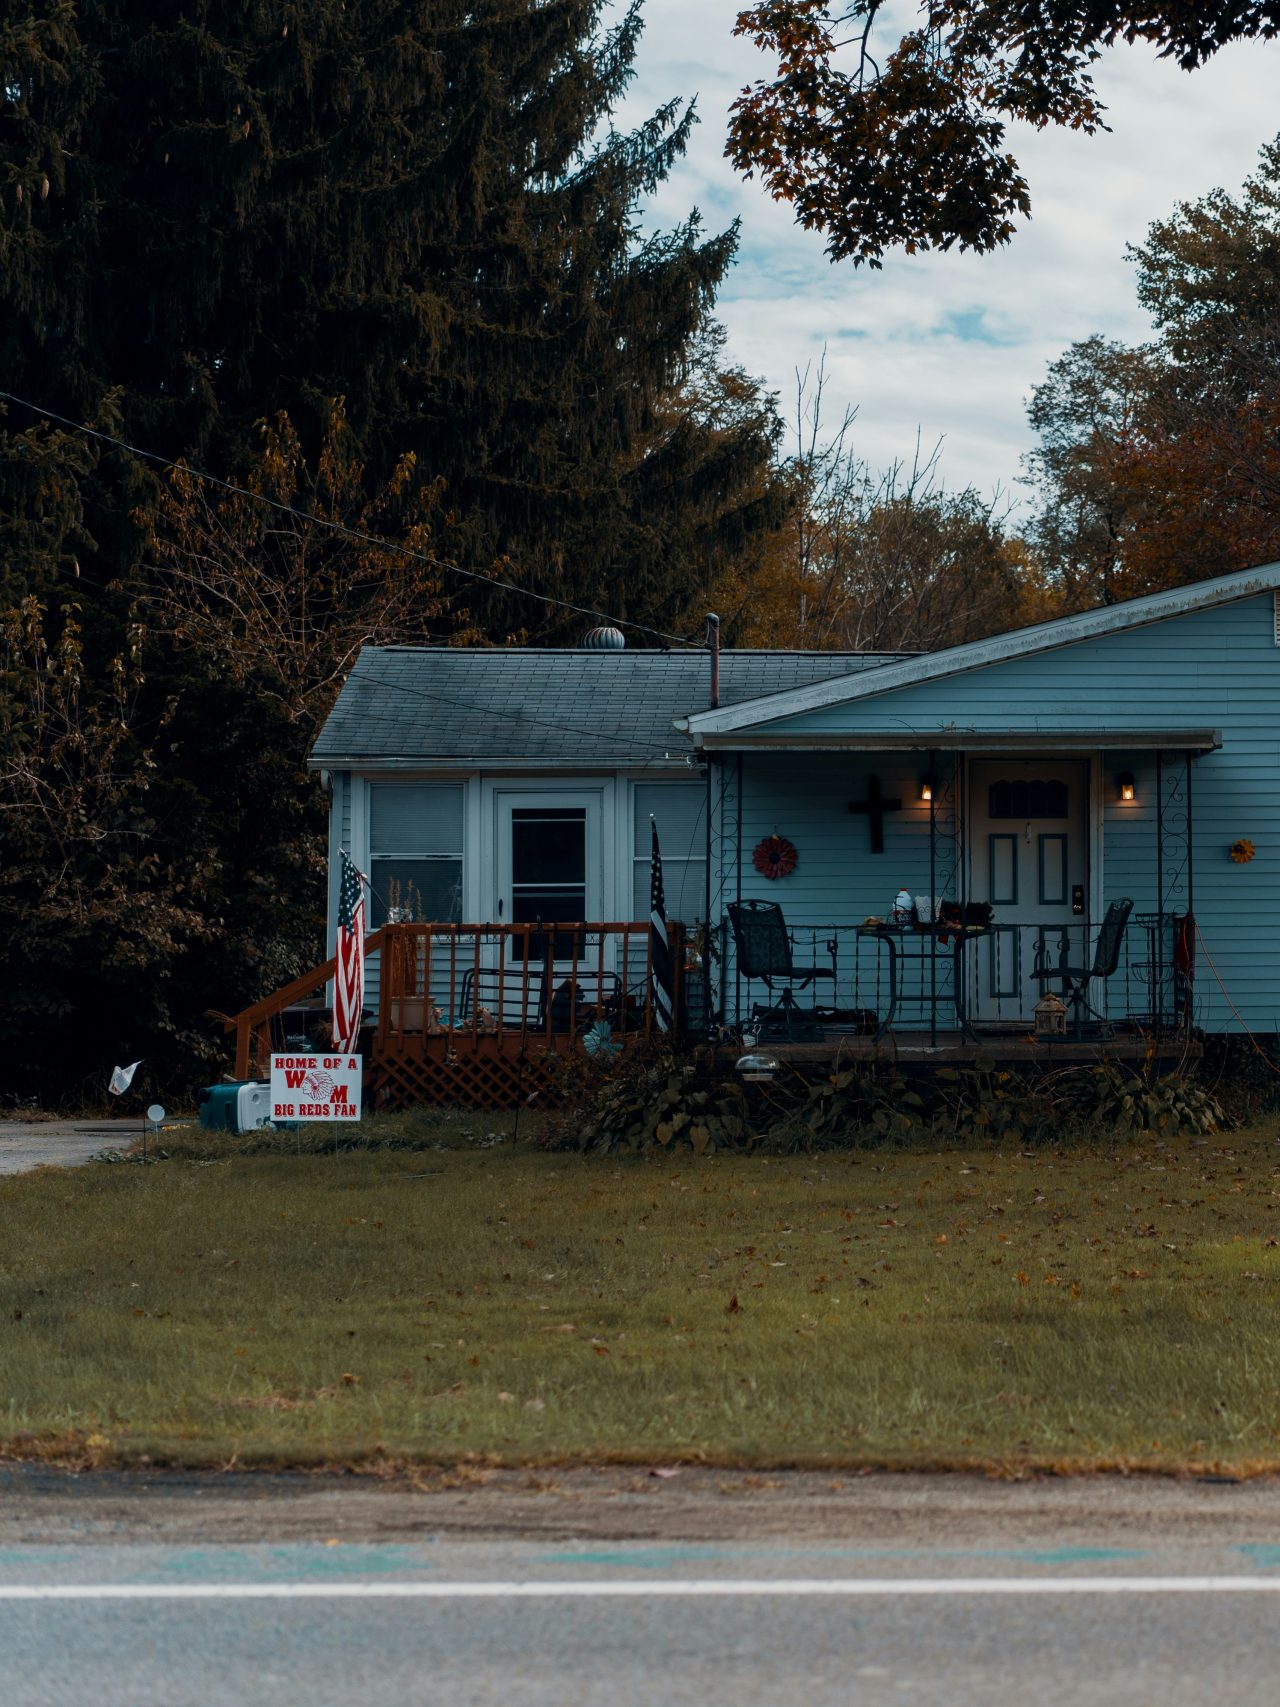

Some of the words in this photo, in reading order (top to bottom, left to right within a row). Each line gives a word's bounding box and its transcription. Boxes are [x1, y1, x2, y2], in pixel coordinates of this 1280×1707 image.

[275, 1058, 317, 1069] HOME
[323, 1058, 342, 1069] OF
[348, 1058, 358, 1069] A
[285, 1070, 306, 1088] W
[330, 1085, 348, 1103] M
[274, 1104, 295, 1117] BIG
[299, 1104, 330, 1117] REDS
[334, 1104, 357, 1117] FAN
